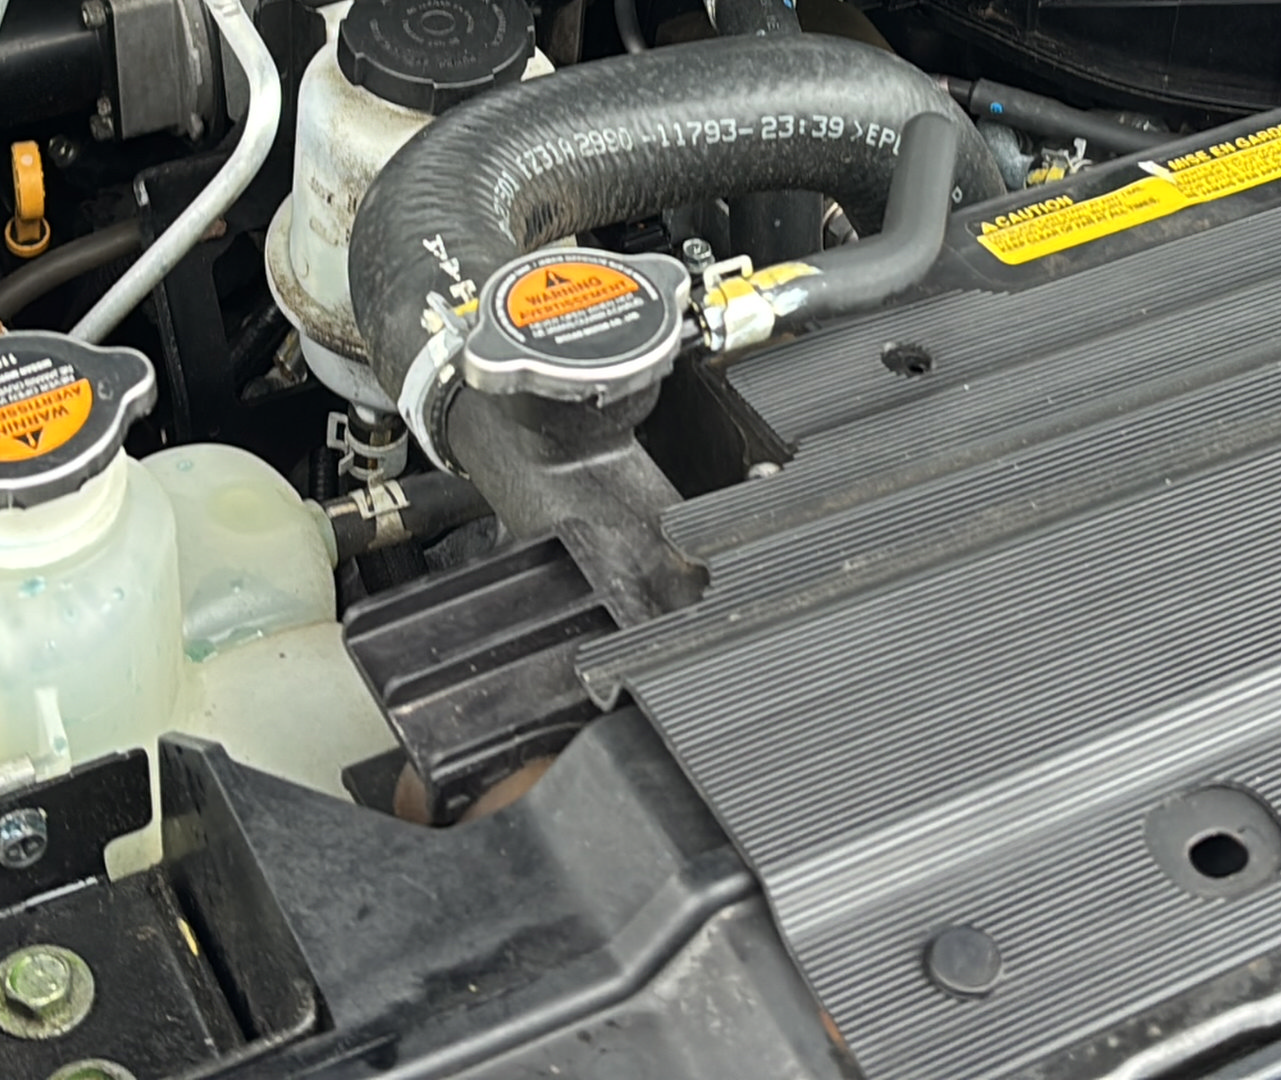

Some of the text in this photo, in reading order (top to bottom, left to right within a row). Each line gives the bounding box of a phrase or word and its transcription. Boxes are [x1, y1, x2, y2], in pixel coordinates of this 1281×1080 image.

[1167, 149, 1212, 171] MISE
[1209, 141, 1236, 159] EN
[995, 195, 1074, 229] CAUTION
[525, 276, 603, 306] WARNING
